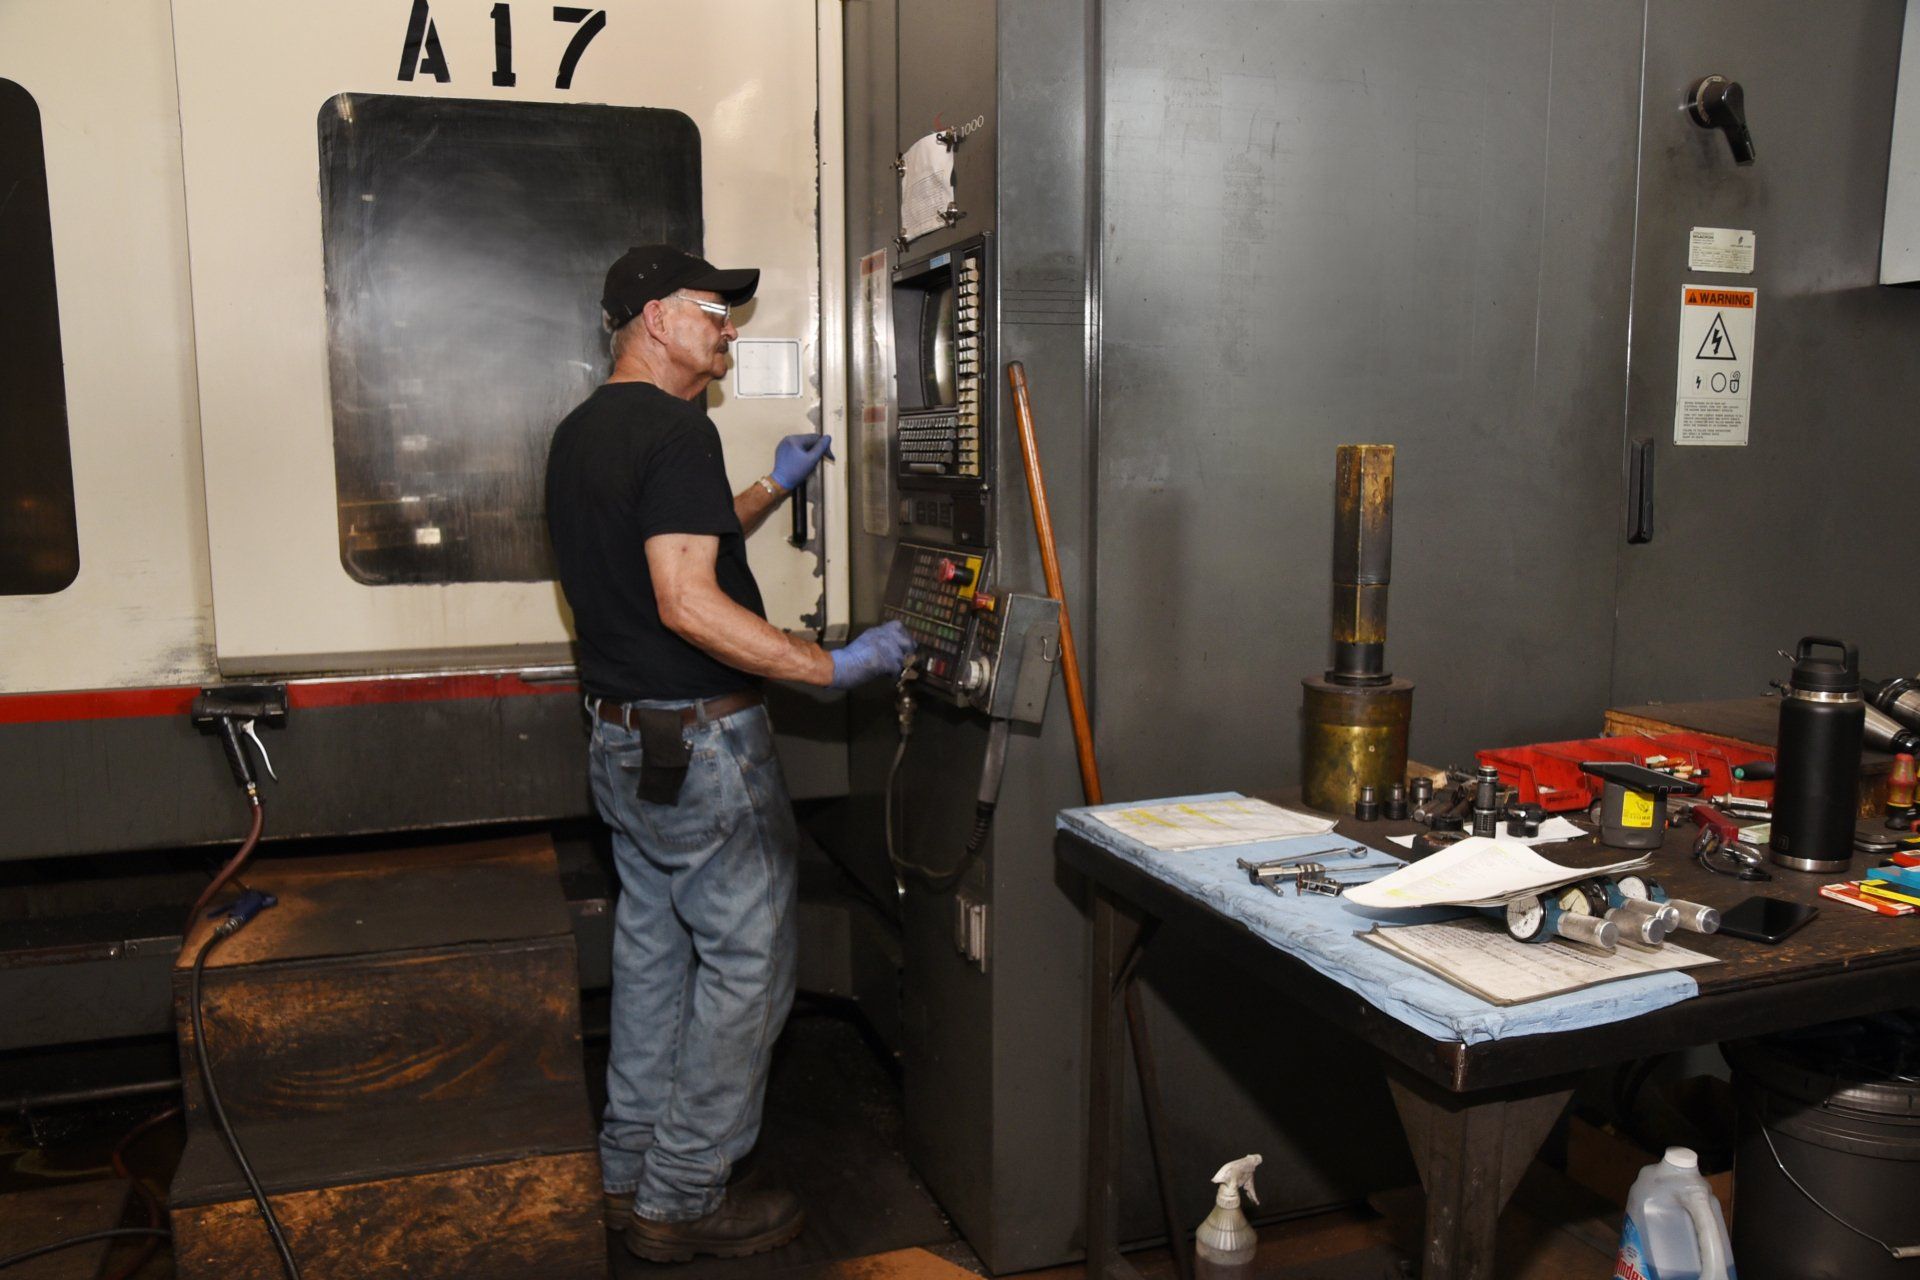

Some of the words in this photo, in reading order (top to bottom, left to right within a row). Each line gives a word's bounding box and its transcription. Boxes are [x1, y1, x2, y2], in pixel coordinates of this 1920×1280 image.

[397, 0, 606, 90] A17
[961, 115, 984, 138] 1000
[1699, 292, 1751, 306] WARNING
